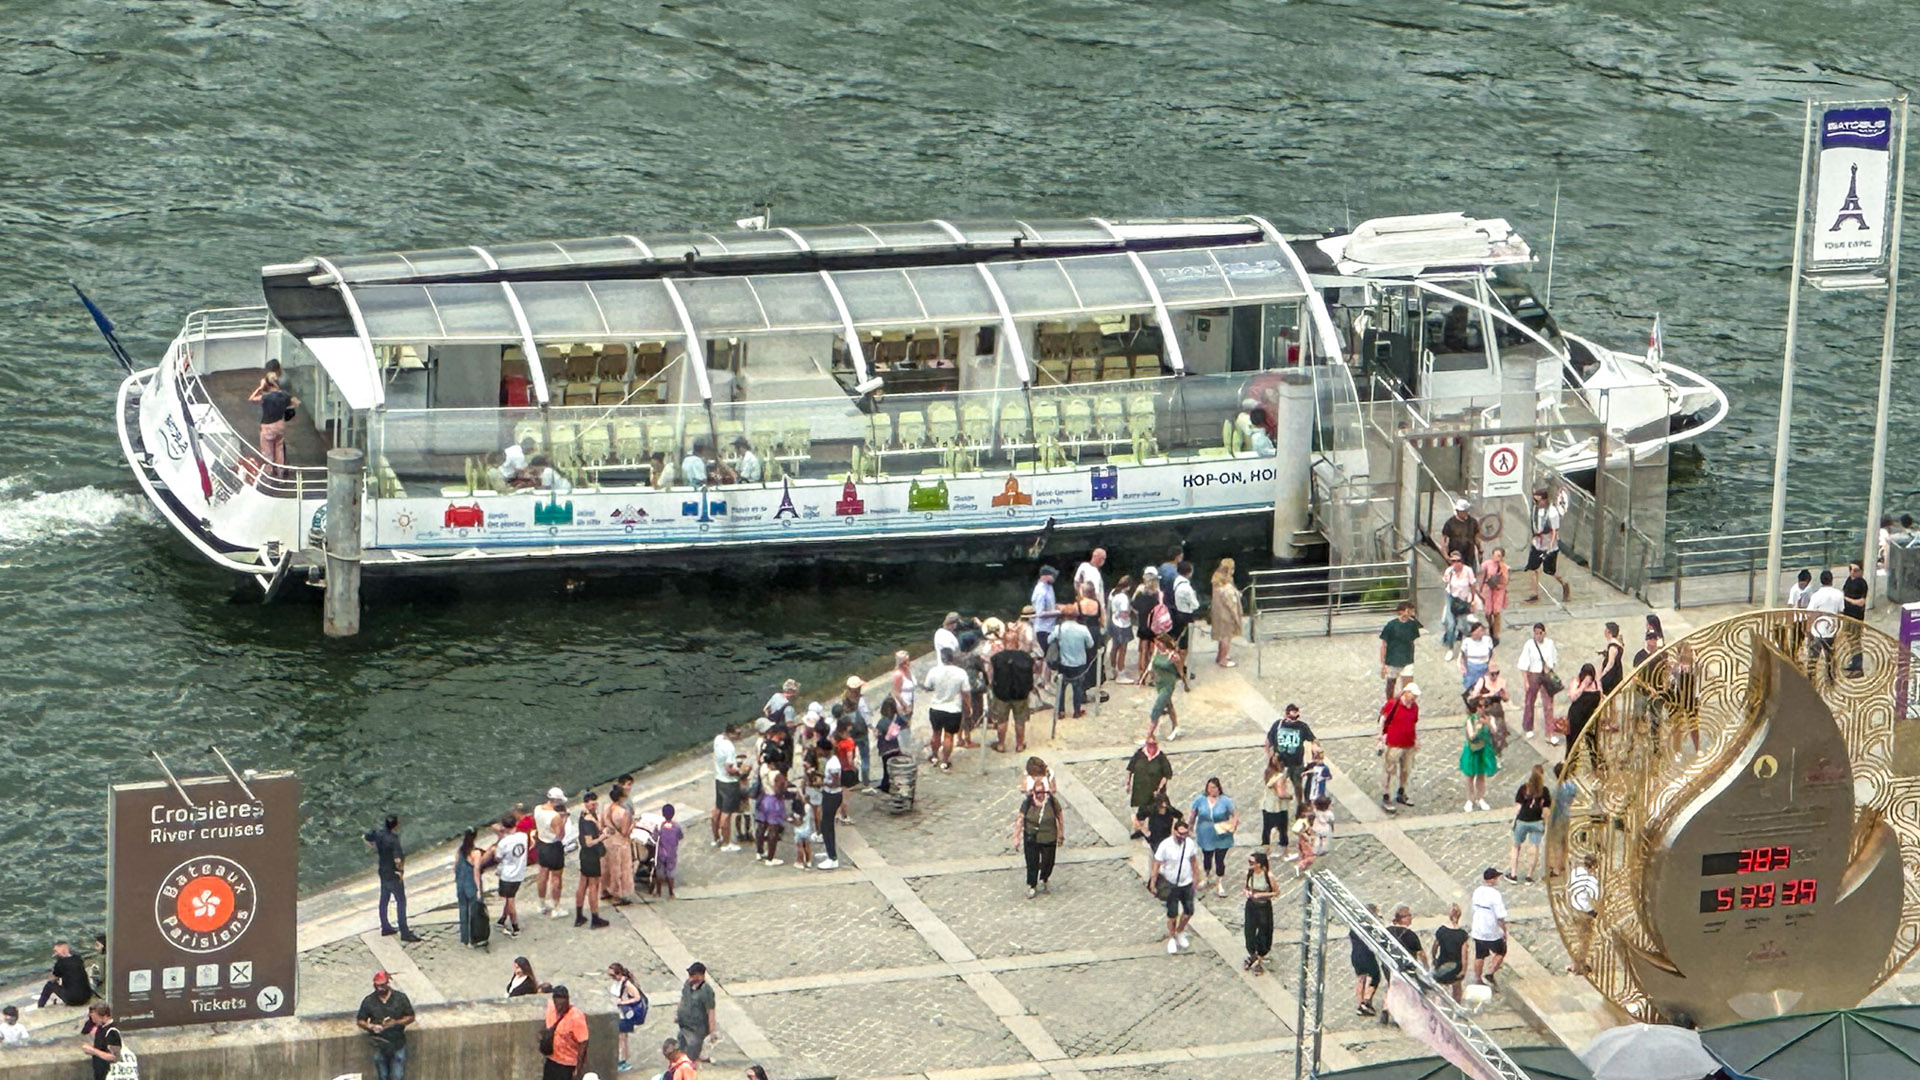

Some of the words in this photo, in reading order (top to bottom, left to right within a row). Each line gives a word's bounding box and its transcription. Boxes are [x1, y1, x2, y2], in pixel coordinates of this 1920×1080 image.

[1183, 471, 1246, 487] HOP-ON,
[1250, 468, 1277, 482] HO
[151, 800, 264, 824] Croisières
[150, 827, 195, 843] River
[200, 822, 264, 839] cruises
[1736, 845, 1791, 875] 383
[162, 863, 246, 898] Bateaux
[1716, 887, 1733, 911] 5
[1740, 882, 1775, 910] 39
[1781, 878, 1816, 905] 39
[162, 910, 248, 948] Parisiens
[190, 998, 247, 1013] Tickets
